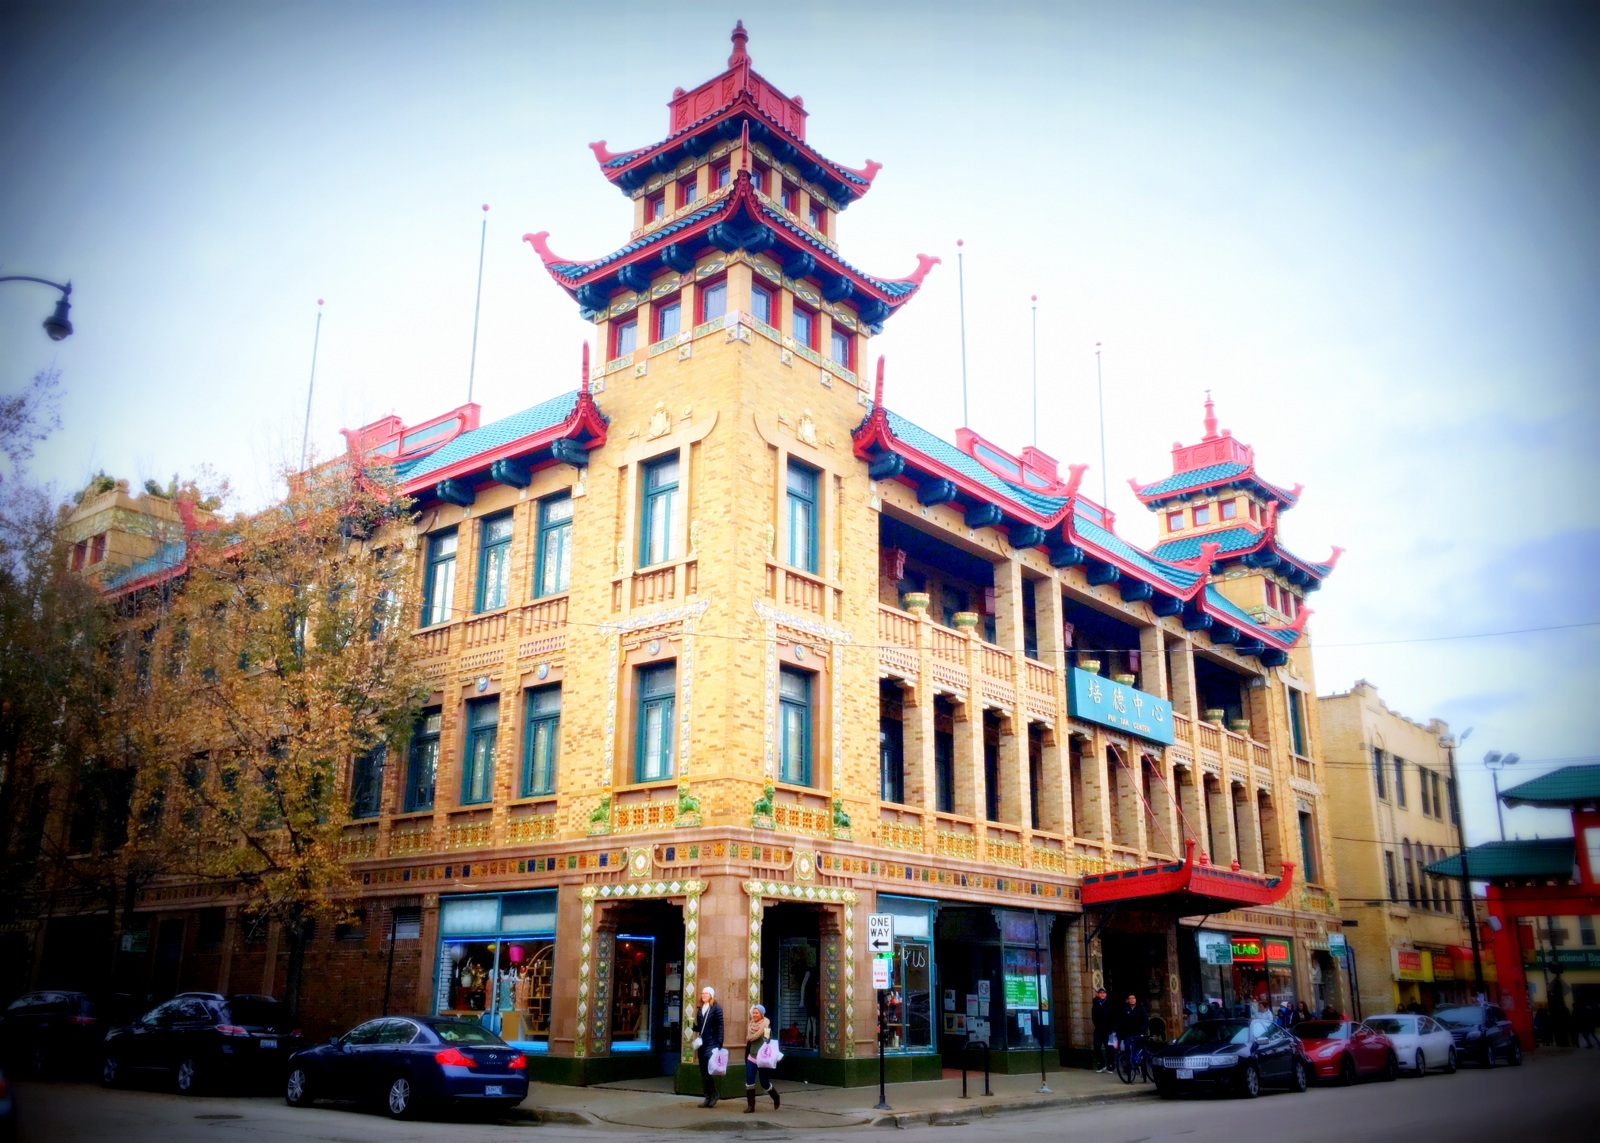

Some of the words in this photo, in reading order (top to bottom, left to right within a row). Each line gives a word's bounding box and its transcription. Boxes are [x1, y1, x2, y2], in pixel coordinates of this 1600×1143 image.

[1108, 714, 1116, 722] PUI
[1133, 722, 1151, 733] CENTER
[870, 918, 889, 926] ONE
[870, 928, 889, 937] WAY
